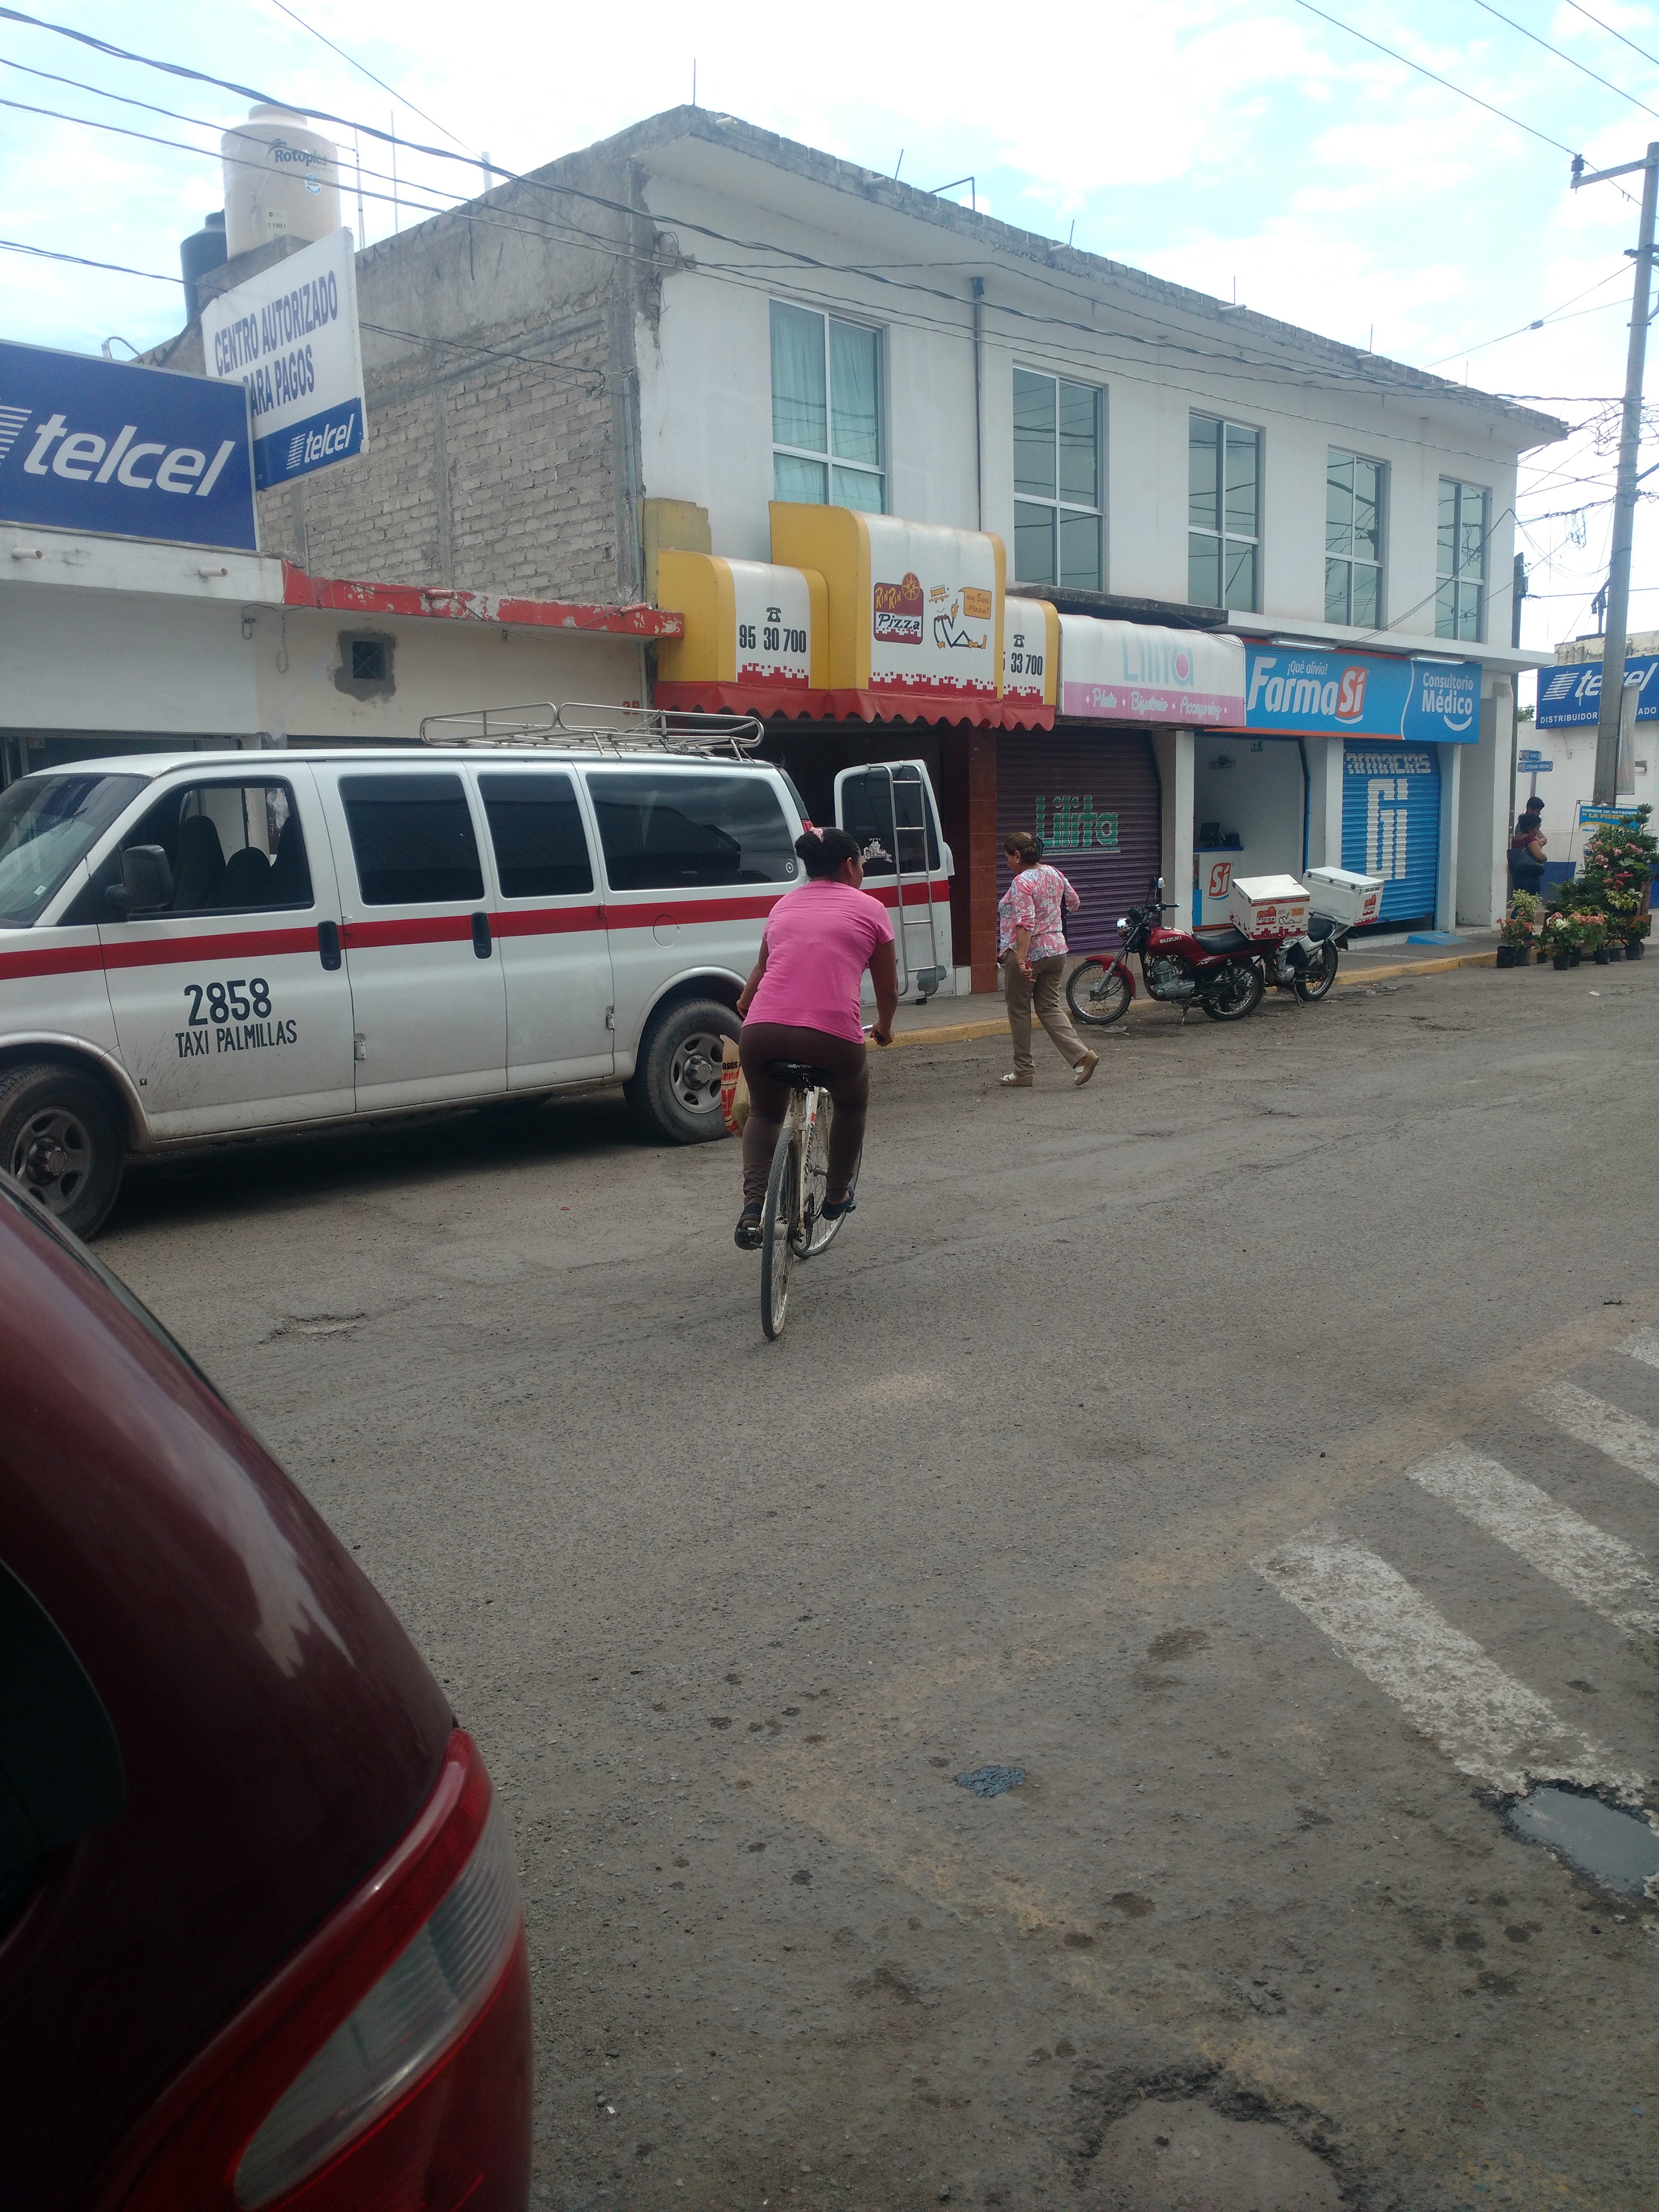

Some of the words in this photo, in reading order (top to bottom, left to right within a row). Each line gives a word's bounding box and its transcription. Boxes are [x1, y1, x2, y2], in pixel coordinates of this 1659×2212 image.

[215, 313, 259, 377] CENTRO
[262, 270, 338, 354] AUTORIZADO
[274, 344, 314, 406] PAGOS
[304, 413, 354, 464] telcel
[24, 414, 236, 496] telcel
[878, 613, 920, 630] Pizza
[739, 624, 756, 649] 95
[764, 627, 779, 651] 30
[783, 628, 806, 653] 700
[1011, 653, 1023, 673] 33
[1025, 654, 1043, 676] 700
[1287, 660, 1305, 676] ¡Qué
[1306, 662, 1328, 676] alivio!
[1423, 672, 1473, 690] Consultorio
[1093, 687, 1117, 708] Plata
[1180, 695, 1222, 721] Accesorios
[1422, 689, 1473, 715] Médico
[1540, 712, 1598, 724] DISTRIBUIDOR
[1159, 936, 1182, 944] SUZUKI
[184, 978, 272, 1026] 2858
[175, 1030, 209, 1058] TAXI
[216, 1019, 297, 1053] PALMILLAS
